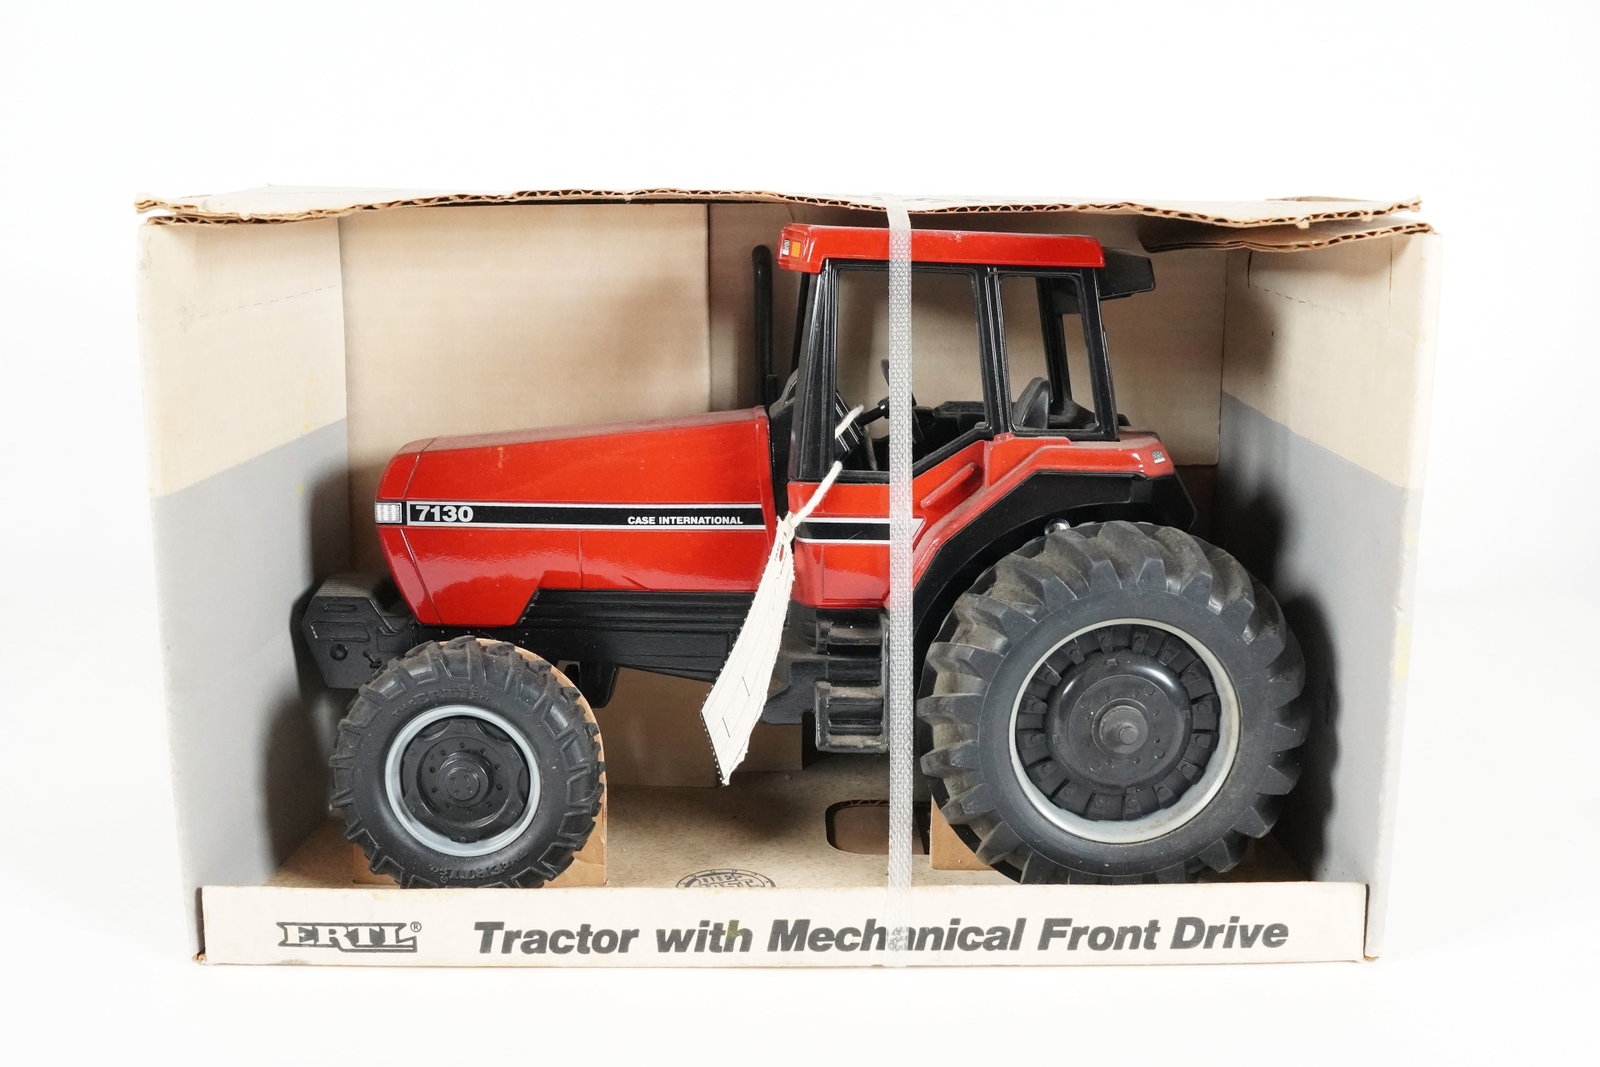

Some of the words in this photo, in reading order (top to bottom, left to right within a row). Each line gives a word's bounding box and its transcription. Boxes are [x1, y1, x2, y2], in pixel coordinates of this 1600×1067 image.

[415, 505, 474, 523] 7130
[627, 516, 656, 525] CASE
[658, 516, 743, 525] INTERNATIONAL
[474, 921, 640, 954] Tractor
[655, 920, 753, 953] with
[766, 918, 1027, 952] Mechnical
[1037, 918, 1161, 951] Front
[1169, 916, 1289, 949] Drive
